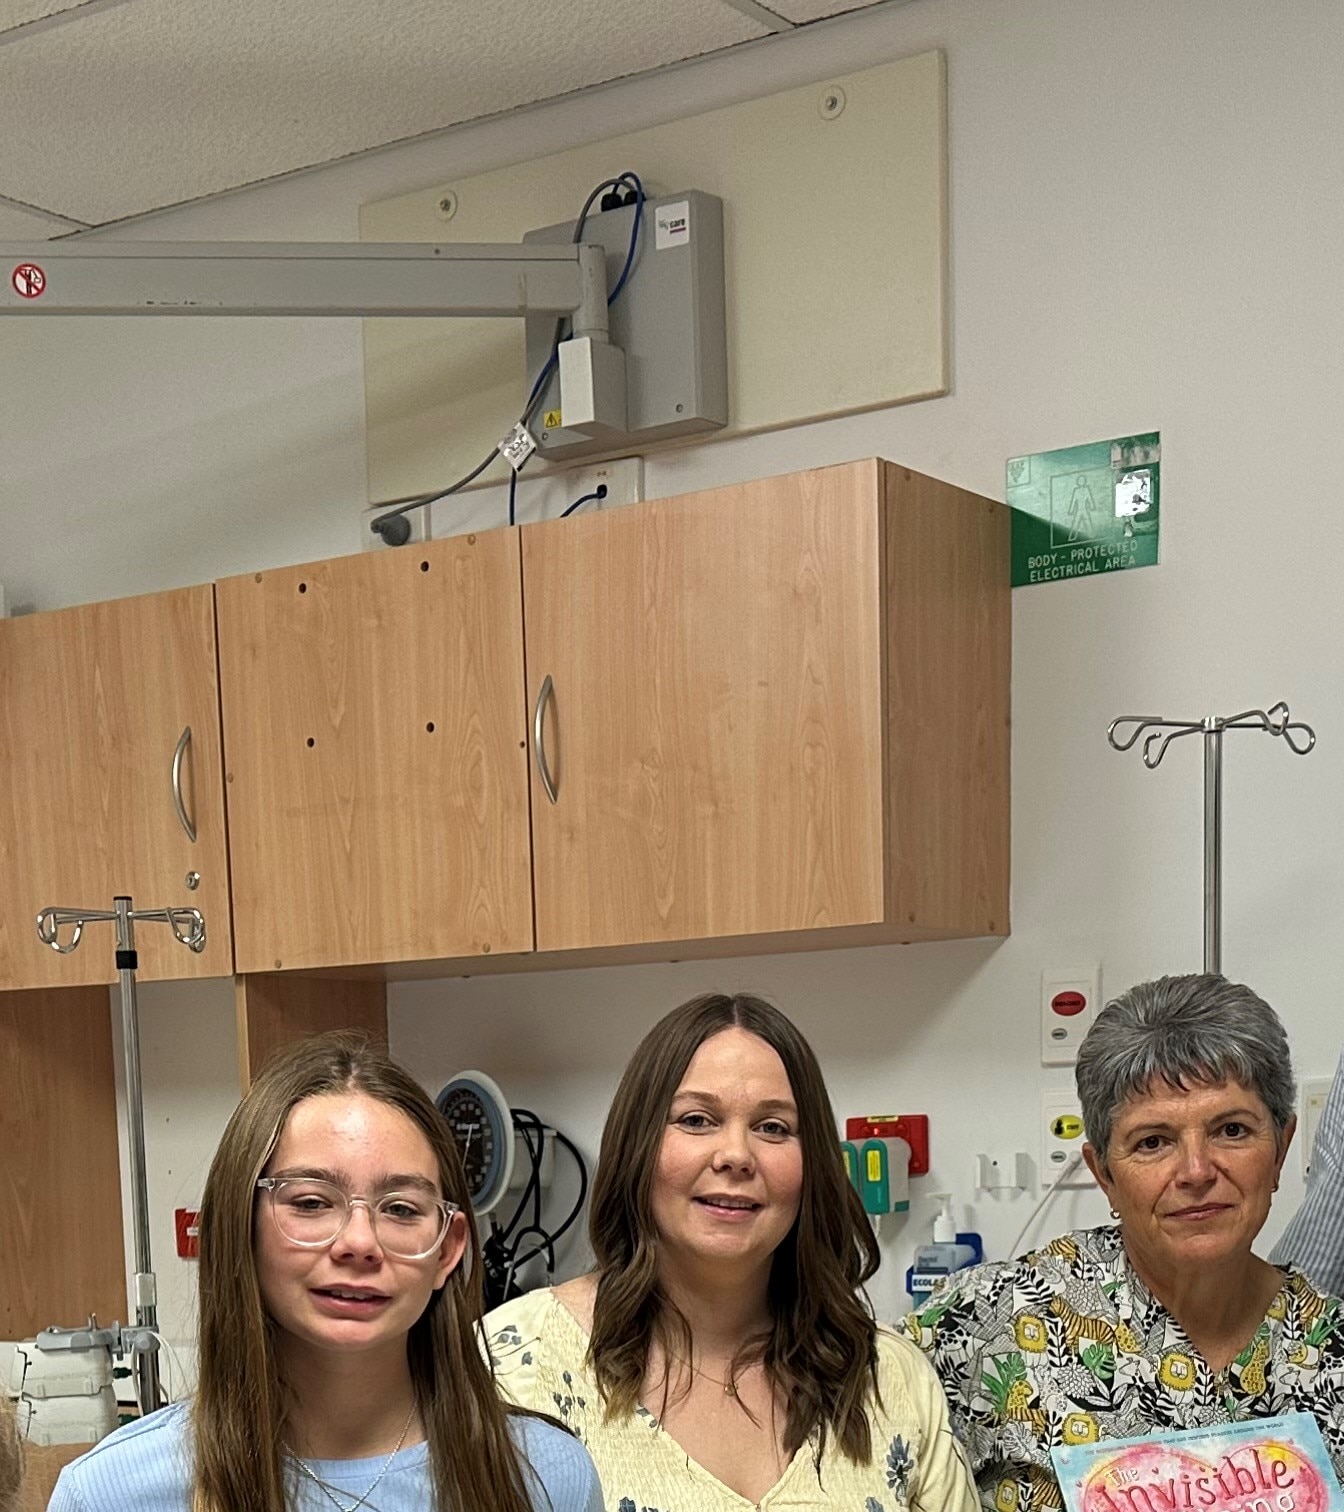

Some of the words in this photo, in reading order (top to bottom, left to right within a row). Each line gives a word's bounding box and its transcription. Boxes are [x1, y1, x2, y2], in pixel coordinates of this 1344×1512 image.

[1028, 554, 1057, 569] BODY
[1071, 540, 1138, 561] PROTECTED
[1030, 562, 1099, 582] ELECTRICAL
[1105, 555, 1136, 569] AREA
[1105, 1466, 1140, 1487] The
